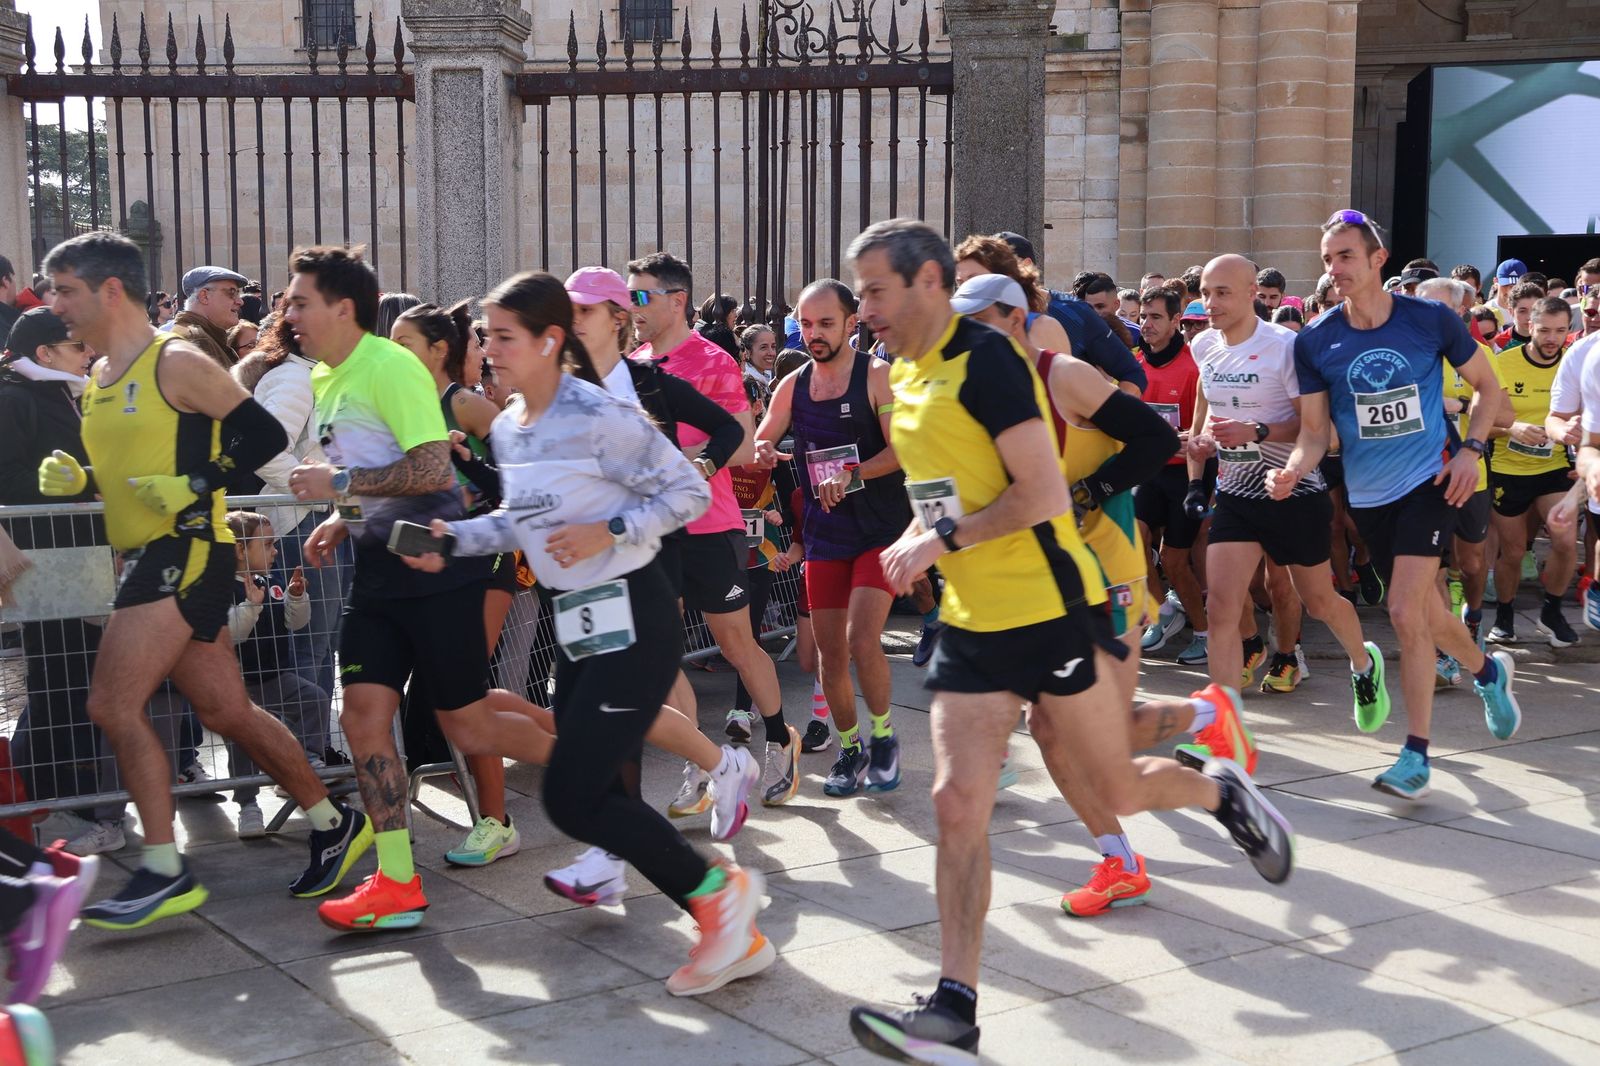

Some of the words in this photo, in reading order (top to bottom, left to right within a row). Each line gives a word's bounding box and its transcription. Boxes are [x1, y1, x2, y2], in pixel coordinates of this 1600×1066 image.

[1351, 361, 1365, 379] MUY
[1363, 352, 1406, 370] SILVESTRE
[1368, 401, 1408, 425] 260
[580, 606, 593, 635] 8
